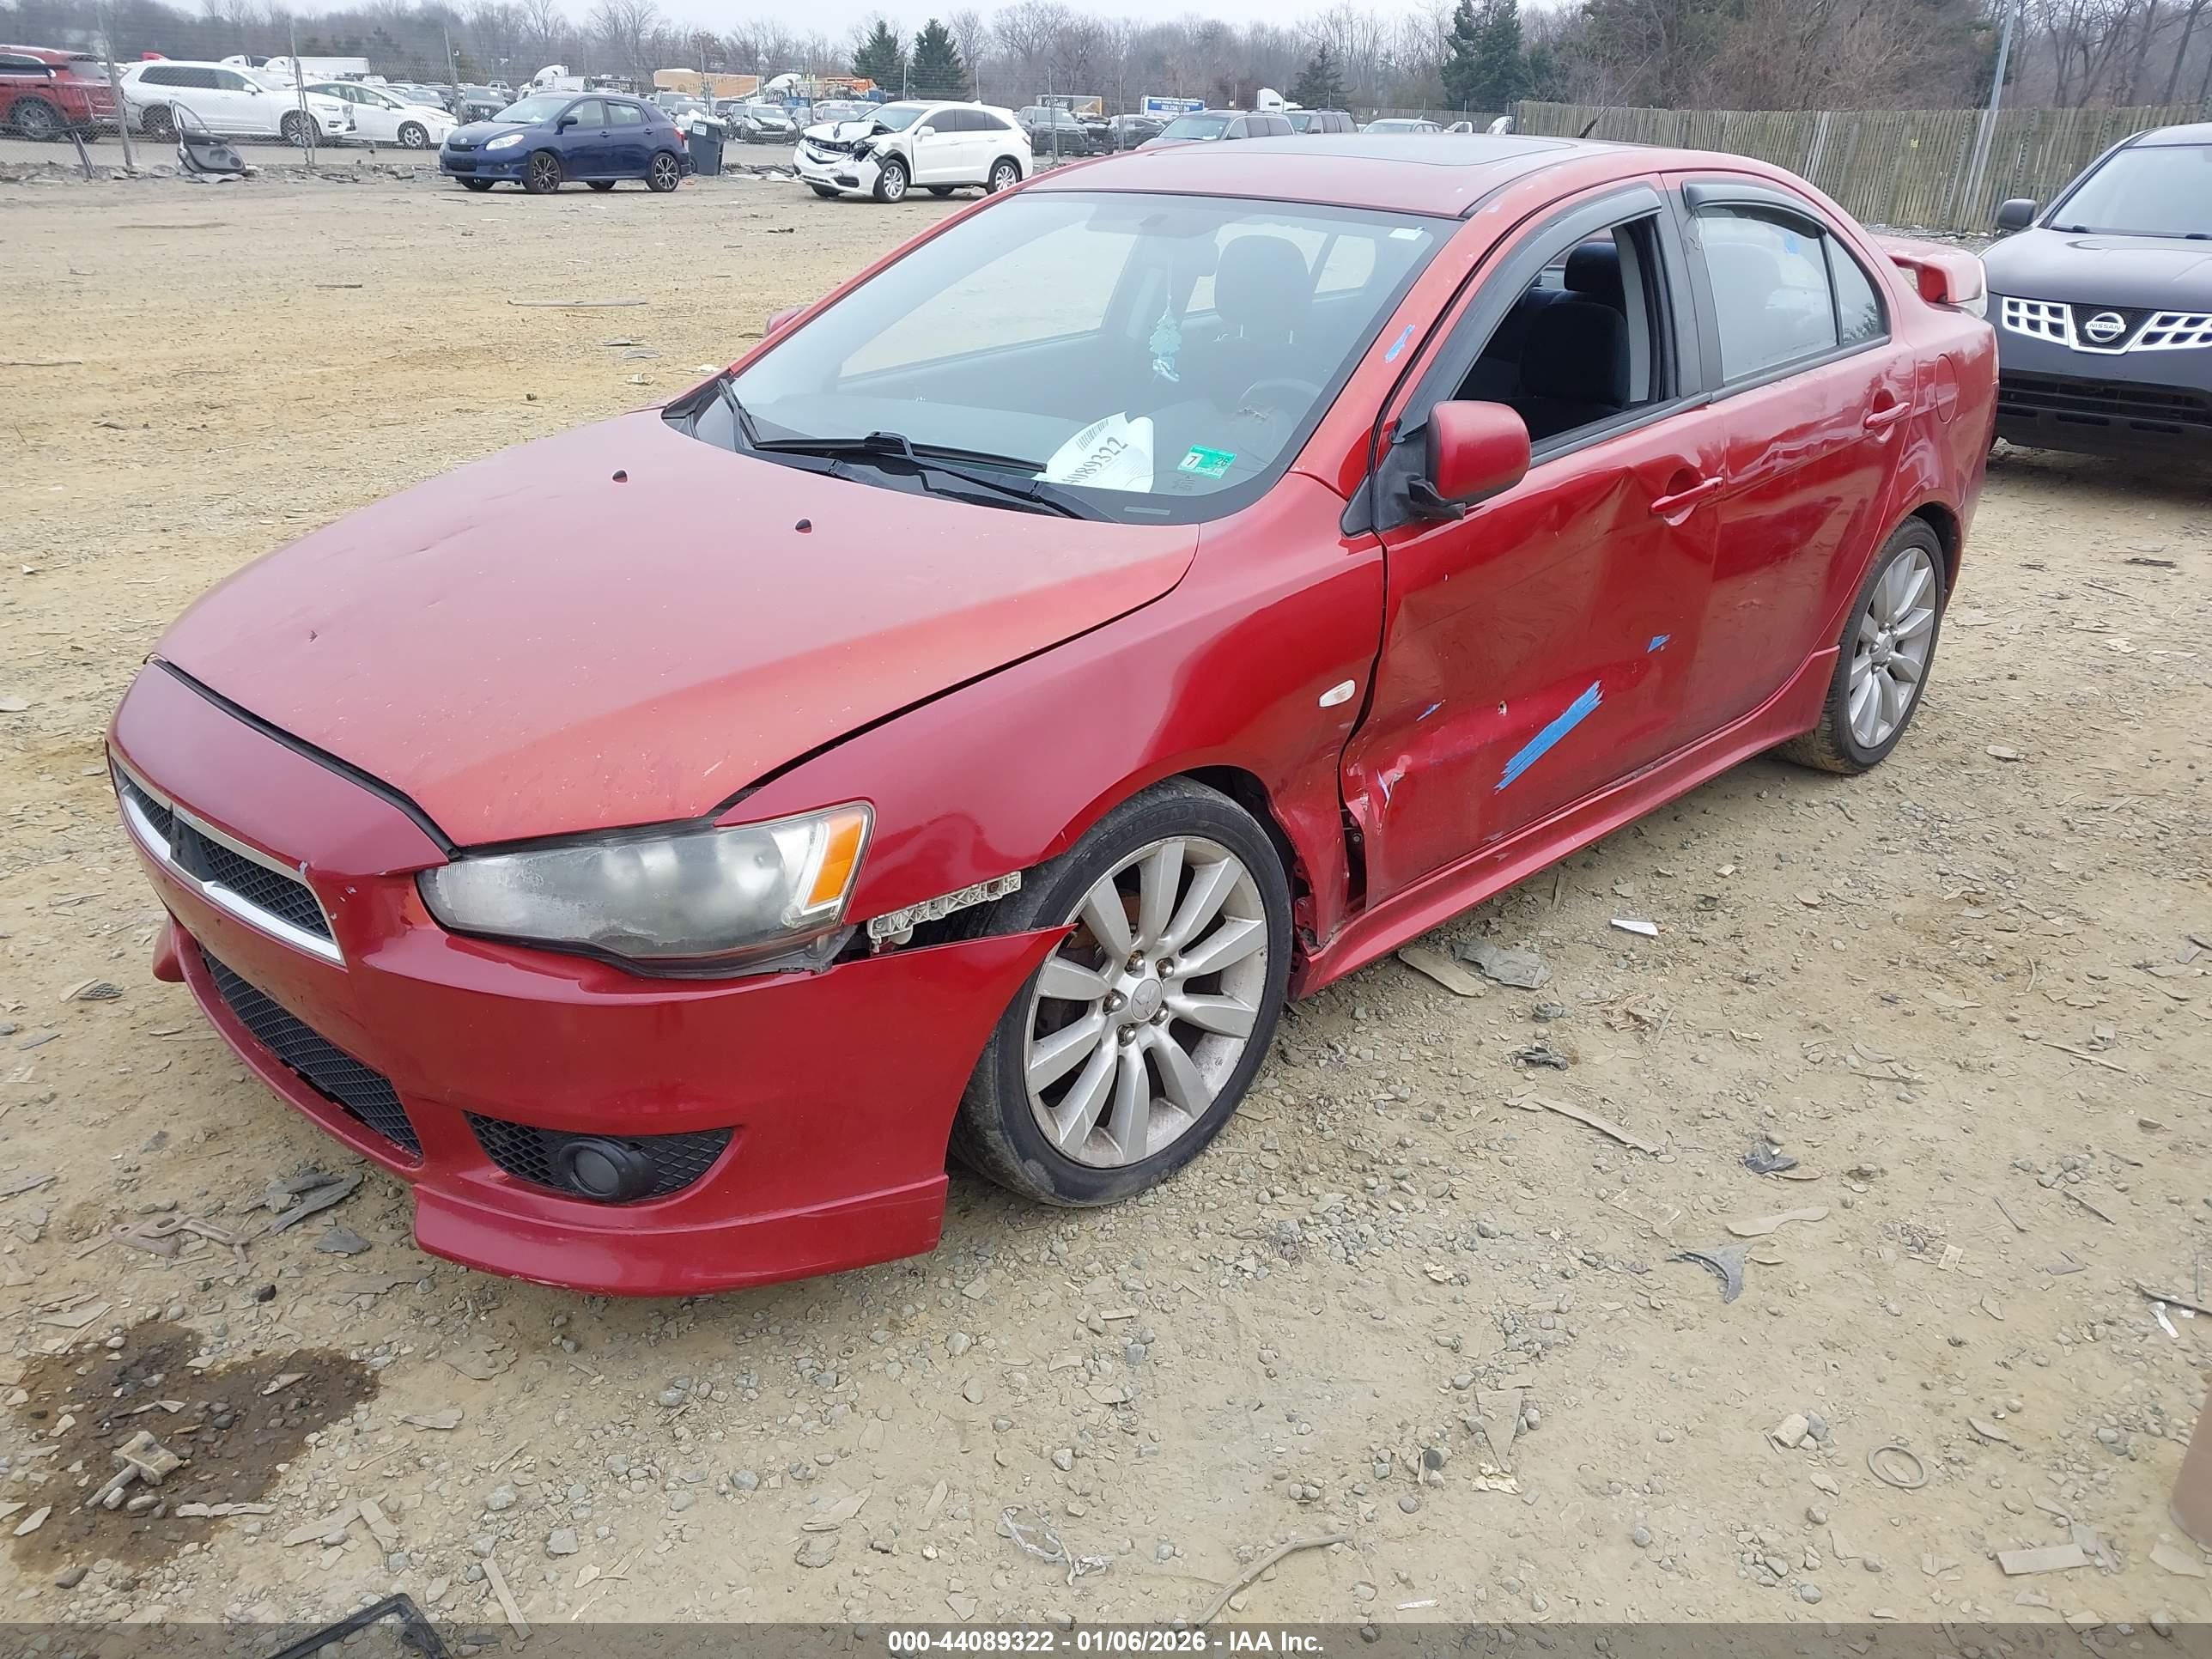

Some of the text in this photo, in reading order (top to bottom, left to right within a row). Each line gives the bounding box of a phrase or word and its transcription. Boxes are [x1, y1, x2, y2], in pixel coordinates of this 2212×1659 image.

[2088, 322, 2121, 331] NISSAN
[1187, 455, 1231, 467] 7 26
